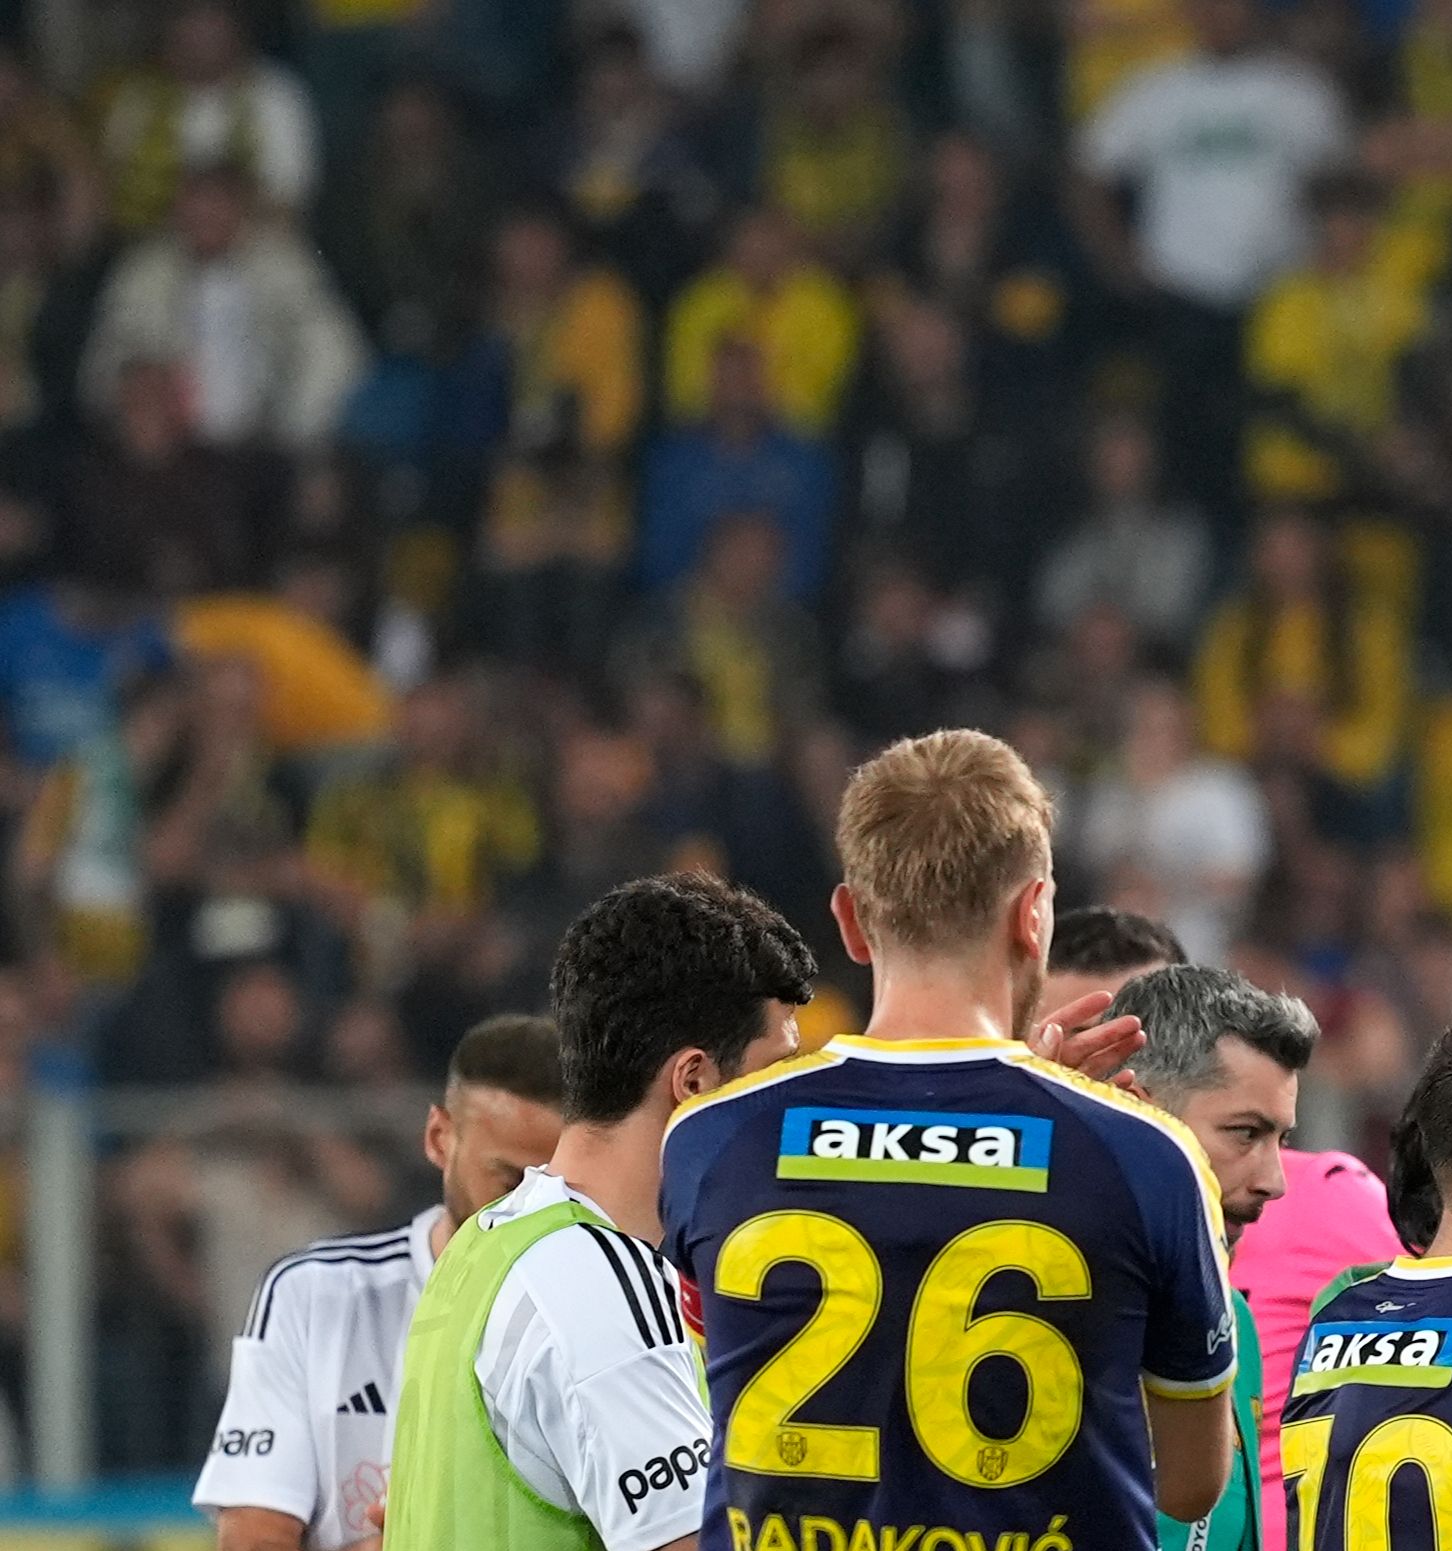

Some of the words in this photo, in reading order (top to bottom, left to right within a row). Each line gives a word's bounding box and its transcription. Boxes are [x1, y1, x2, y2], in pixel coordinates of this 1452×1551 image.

[811, 1118, 1016, 1168] aksa
[714, 1209, 1092, 1489] 26
[1311, 1329, 1440, 1373] aksa
[213, 1429, 275, 1456] ara
